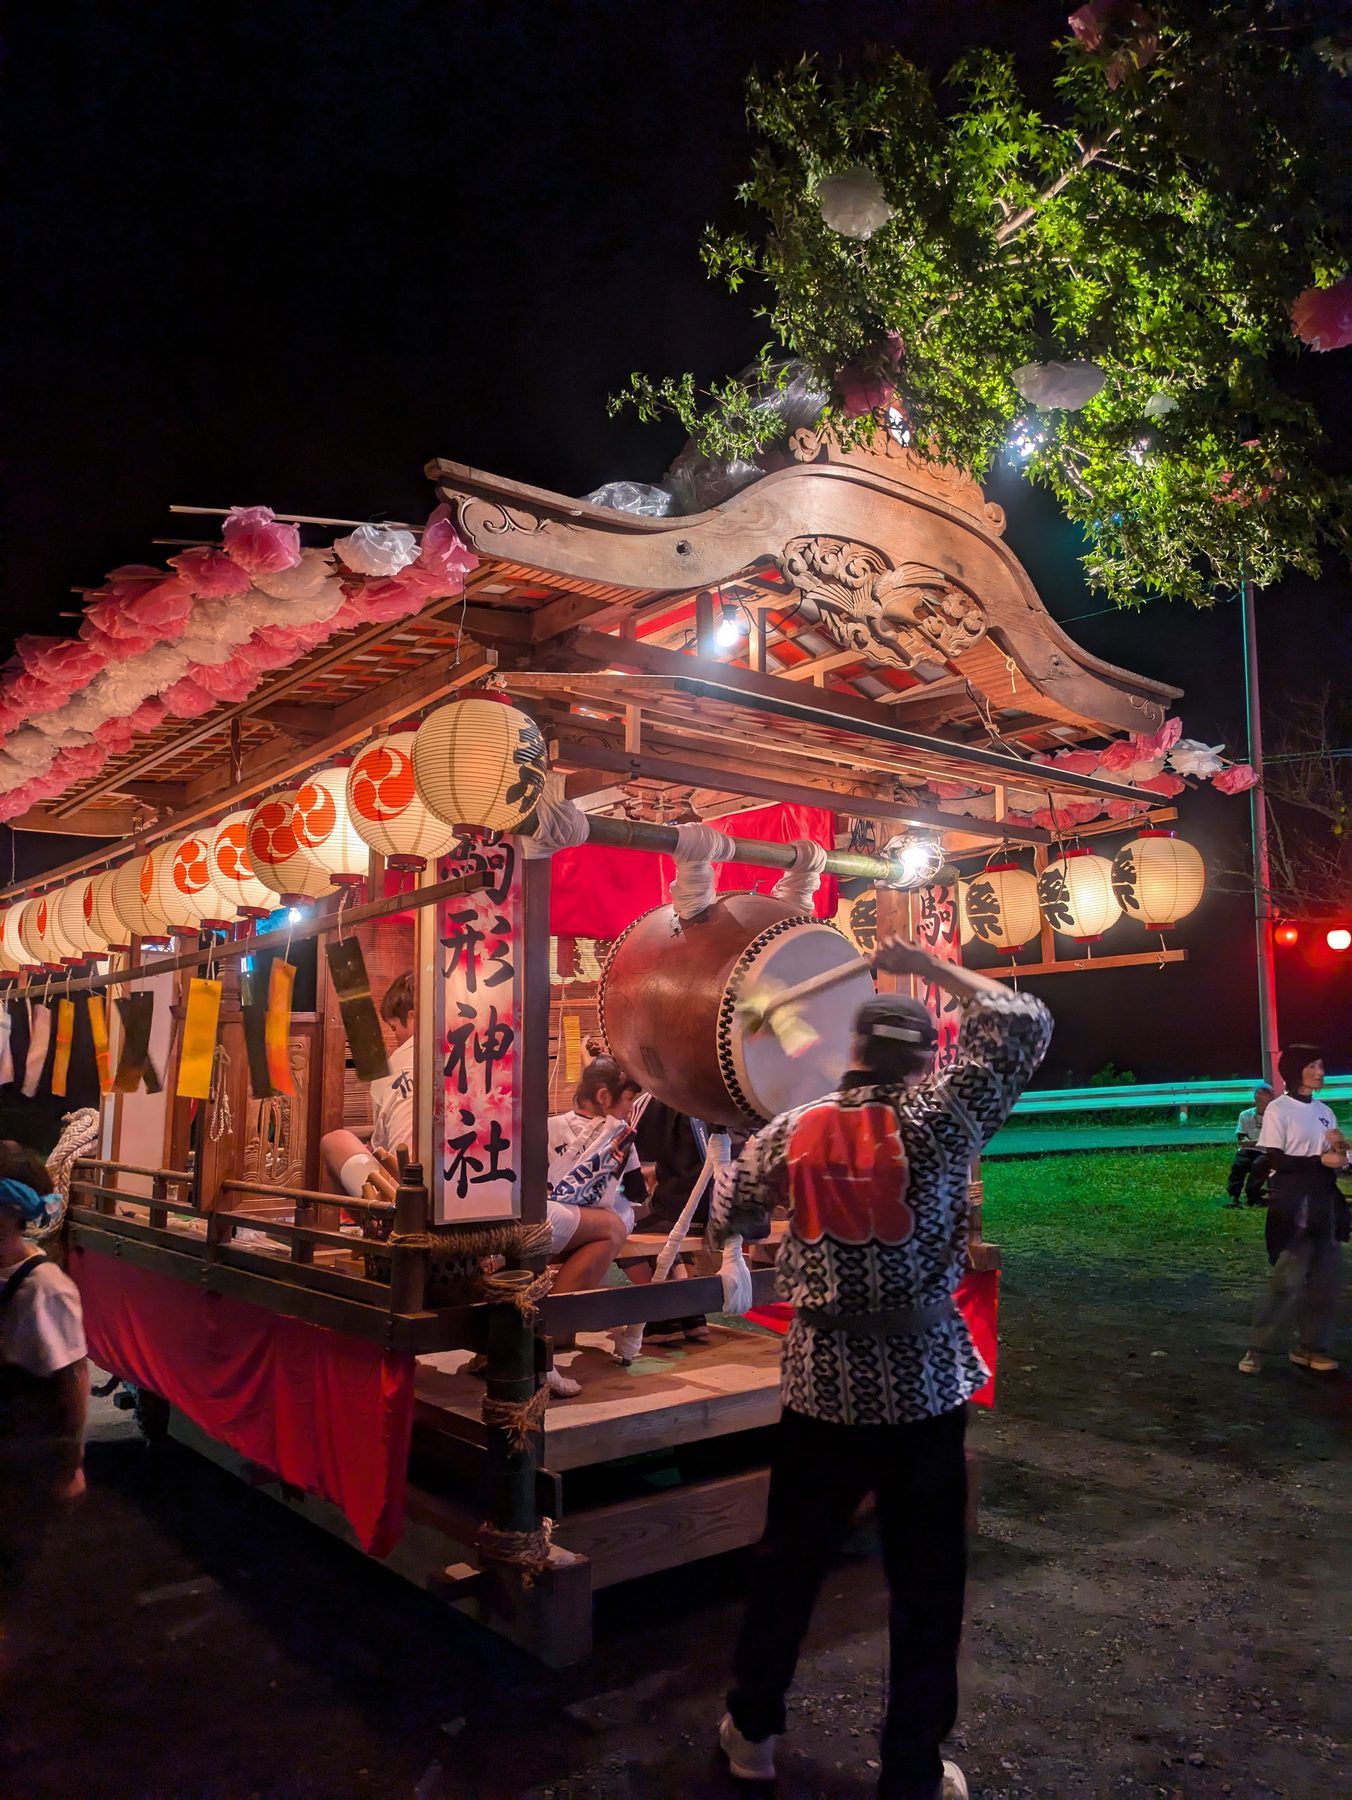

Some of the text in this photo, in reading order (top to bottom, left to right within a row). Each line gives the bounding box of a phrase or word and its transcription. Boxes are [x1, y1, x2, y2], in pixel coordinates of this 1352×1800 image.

[966, 881, 1003, 939] 祭
[1038, 868, 1075, 930] 祭
[440, 832, 517, 1199] 駒形神社
